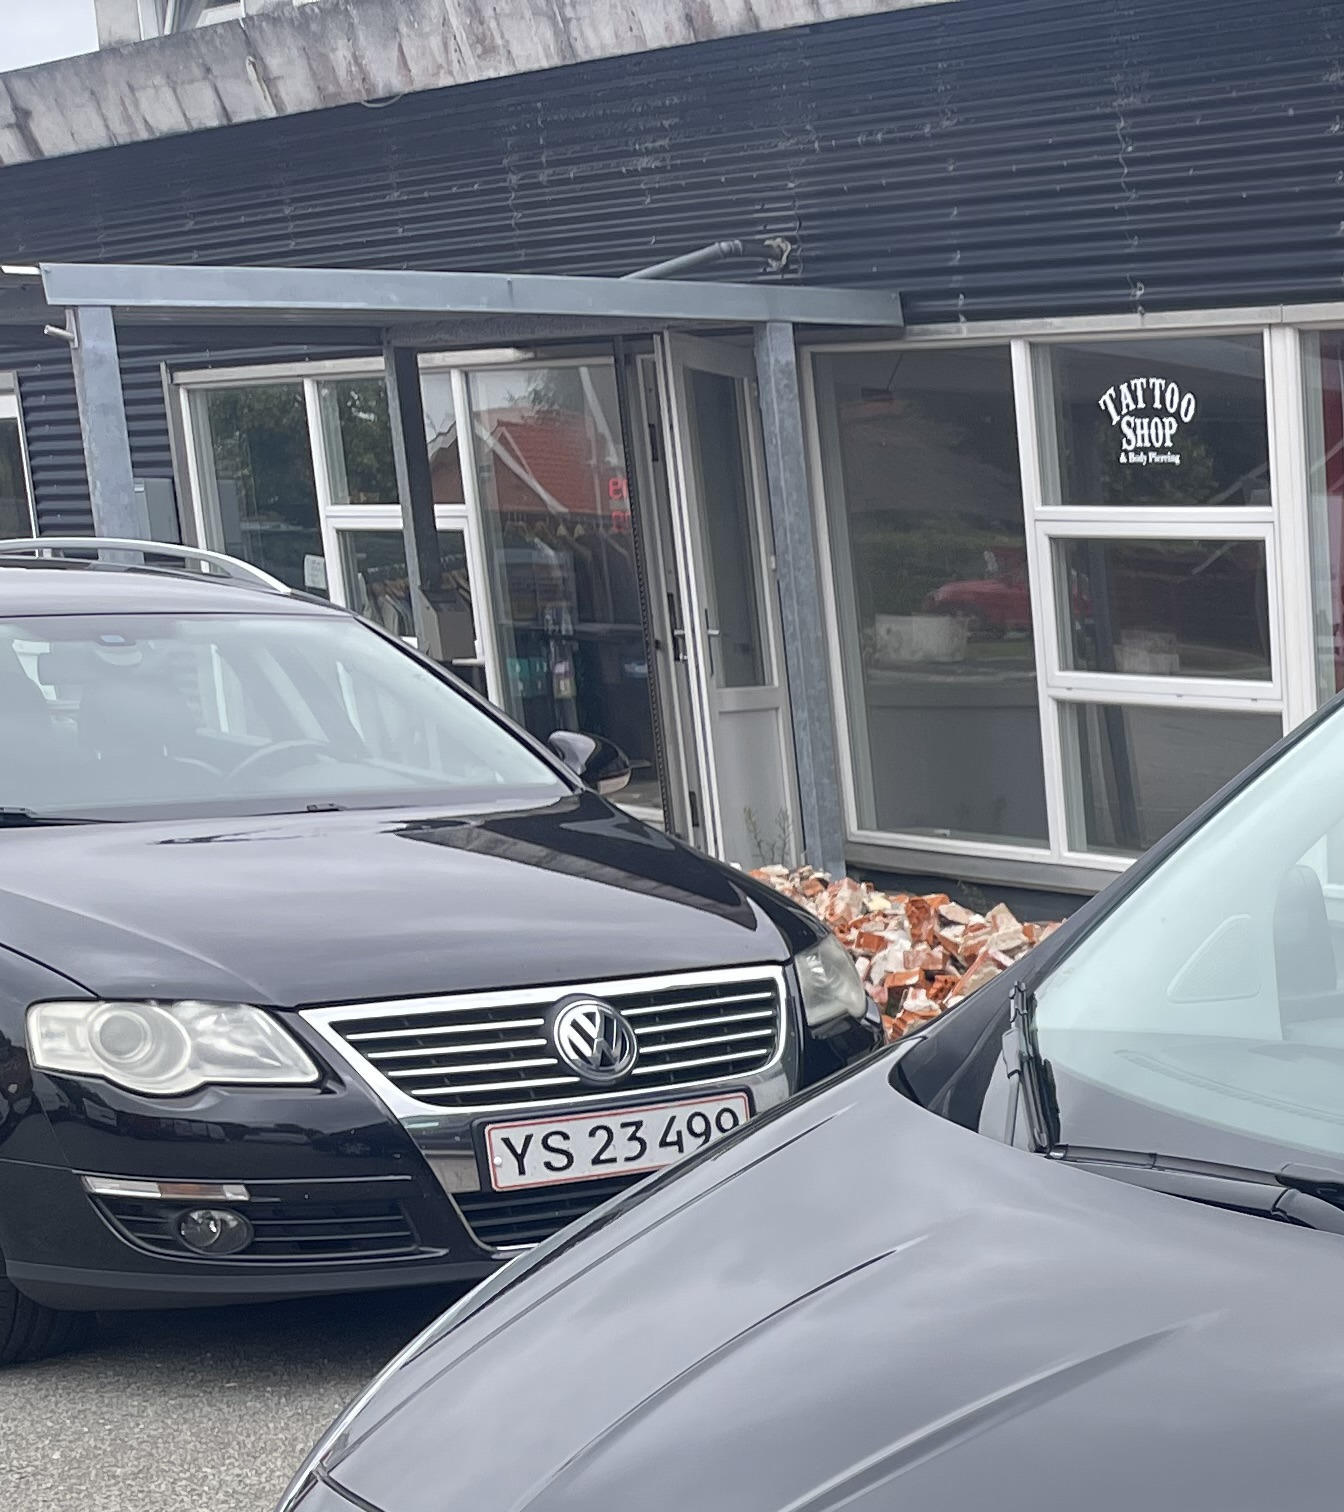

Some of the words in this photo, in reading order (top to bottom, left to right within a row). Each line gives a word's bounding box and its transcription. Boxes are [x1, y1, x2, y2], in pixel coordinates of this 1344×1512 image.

[1099, 377, 1196, 425] TATTOO
[1120, 415, 1178, 450] SHOP
[1120, 451, 1127, 463] &
[501, 1130, 575, 1176] YS
[588, 1120, 647, 1166] 23
